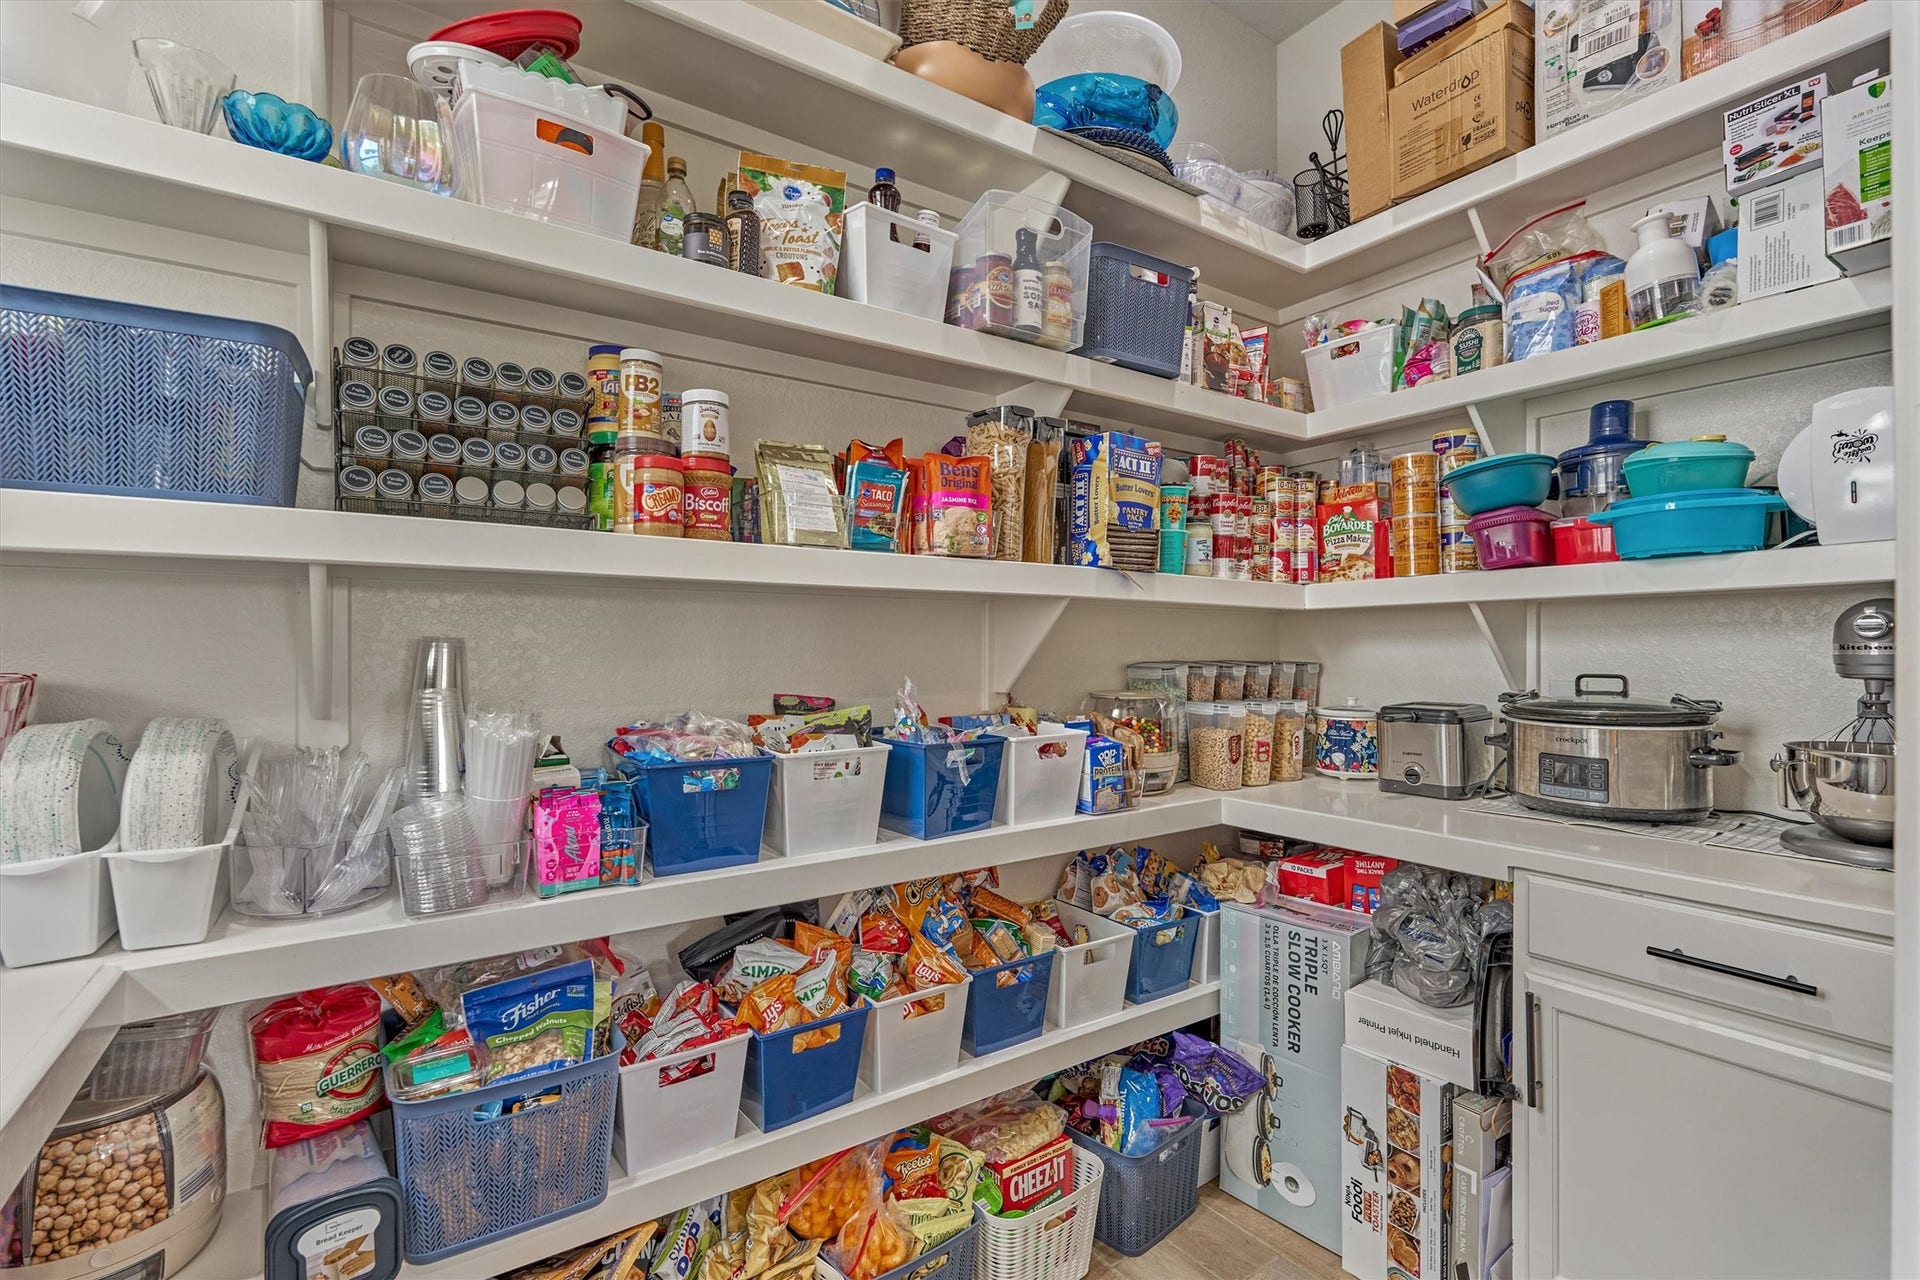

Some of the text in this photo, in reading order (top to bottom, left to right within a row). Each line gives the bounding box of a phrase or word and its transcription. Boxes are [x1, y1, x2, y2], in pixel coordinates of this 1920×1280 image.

[1411, 69, 1480, 112] Waterdrop
[1729, 87, 1799, 122] Nutri Slicer XL
[1876, 102, 1890, 111] THE
[1473, 119, 1496, 133] FRAGILE
[1546, 113, 1581, 130] Hamilton
[1565, 114, 1590, 127] Beach
[1859, 131, 1891, 146] Keeps
[781, 229, 820, 245] Toast
[775, 252, 809, 261] CROUTONS
[1458, 338, 1479, 349] SUSHI
[624, 374, 660, 396] PB2
[1118, 457, 1151, 474] ACT II
[941, 477, 978, 490] Original
[1116, 483, 1154, 498] Butter Lovers
[645, 488, 680, 511] CREAMY
[870, 488, 893, 501] TACO
[941, 496, 967, 504] JASMINE
[1333, 485, 1363, 501] Velveeta
[685, 493, 730, 513] Biscoff
[860, 500, 891, 510] Seasoning
[1075, 498, 1085, 528] ACT
[1122, 507, 1149, 518] PANTRY
[1126, 514, 1144, 523] PACK
[1323, 520, 1373, 537] BOYARDEE
[1325, 534, 1370, 548] Pizza Maker
[1839, 643, 1895, 651] Kitchen
[1555, 736, 1589, 745] crockpot
[1093, 763, 1122, 778] PROTEIN
[1296, 866, 1314, 875] PACKS
[1354, 860, 1386, 869] ANYTIME
[1365, 867, 1385, 875] SNACK
[914, 961, 942, 982] Lay's
[1304, 936, 1318, 996] TRIPLE
[1272, 975, 1279, 985] DE
[1287, 930, 1301, 1054] SLOW COOKER
[501, 988, 561, 1031] Fisher
[612, 991, 646, 1022] oldfish
[495, 1017, 568, 1044] Chopped Walnuts
[1358, 1016, 1460, 1059] Handheld Inkjet Printer
[319, 1054, 383, 1092] GUERRERO
[330, 1105, 352, 1114] MAIZ
[1010, 1163, 1026, 1173] FAMILY
[1009, 1154, 1066, 1203] CHEEZ-IT
[1351, 1177, 1363, 1224] Foodi
[1459, 1196, 1467, 1214] IRON
[1372, 1190, 1380, 1233] TOASTER
[316, 1233, 337, 1246] Bread
[338, 1224, 363, 1237] Keeper
